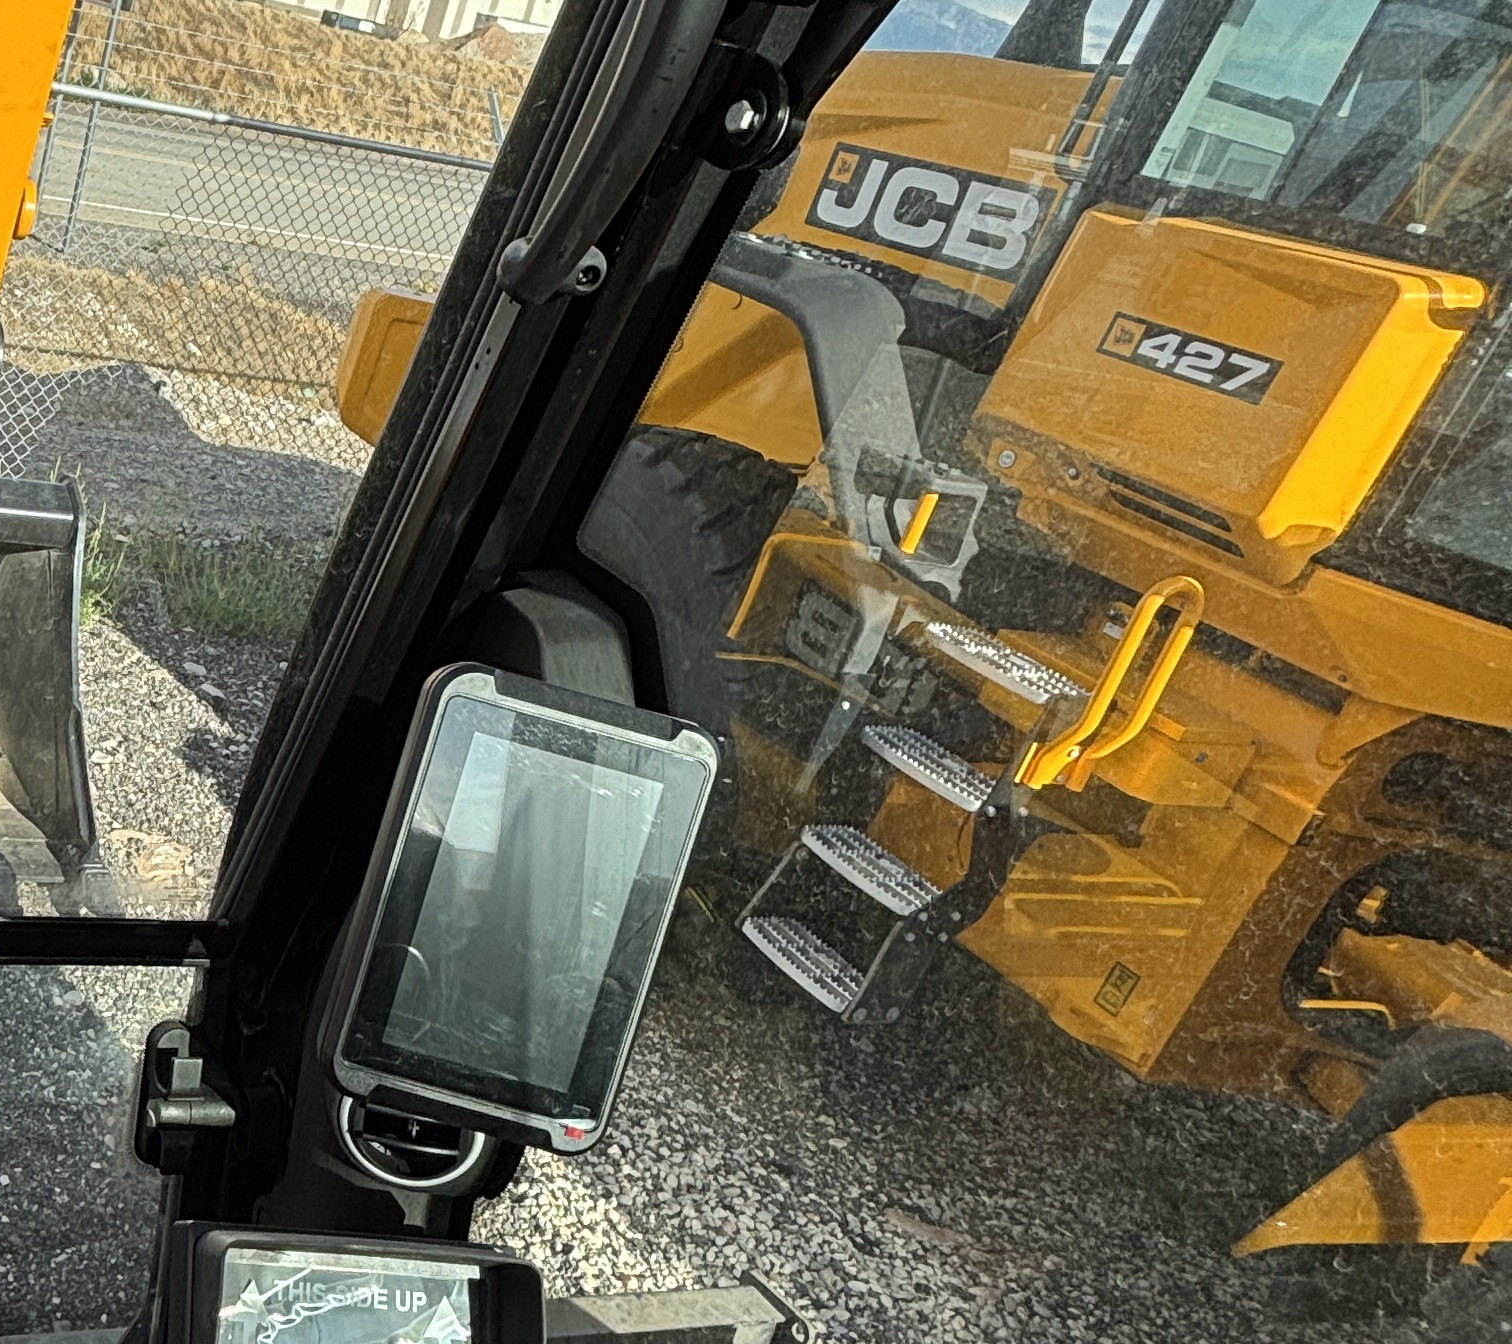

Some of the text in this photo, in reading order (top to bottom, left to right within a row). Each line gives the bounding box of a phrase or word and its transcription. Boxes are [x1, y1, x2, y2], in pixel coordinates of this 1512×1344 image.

[816, 159, 1039, 269] JCB
[1137, 333, 1270, 391] 427
[274, 1280, 326, 1302] THIS
[395, 1290, 427, 1313] UP
